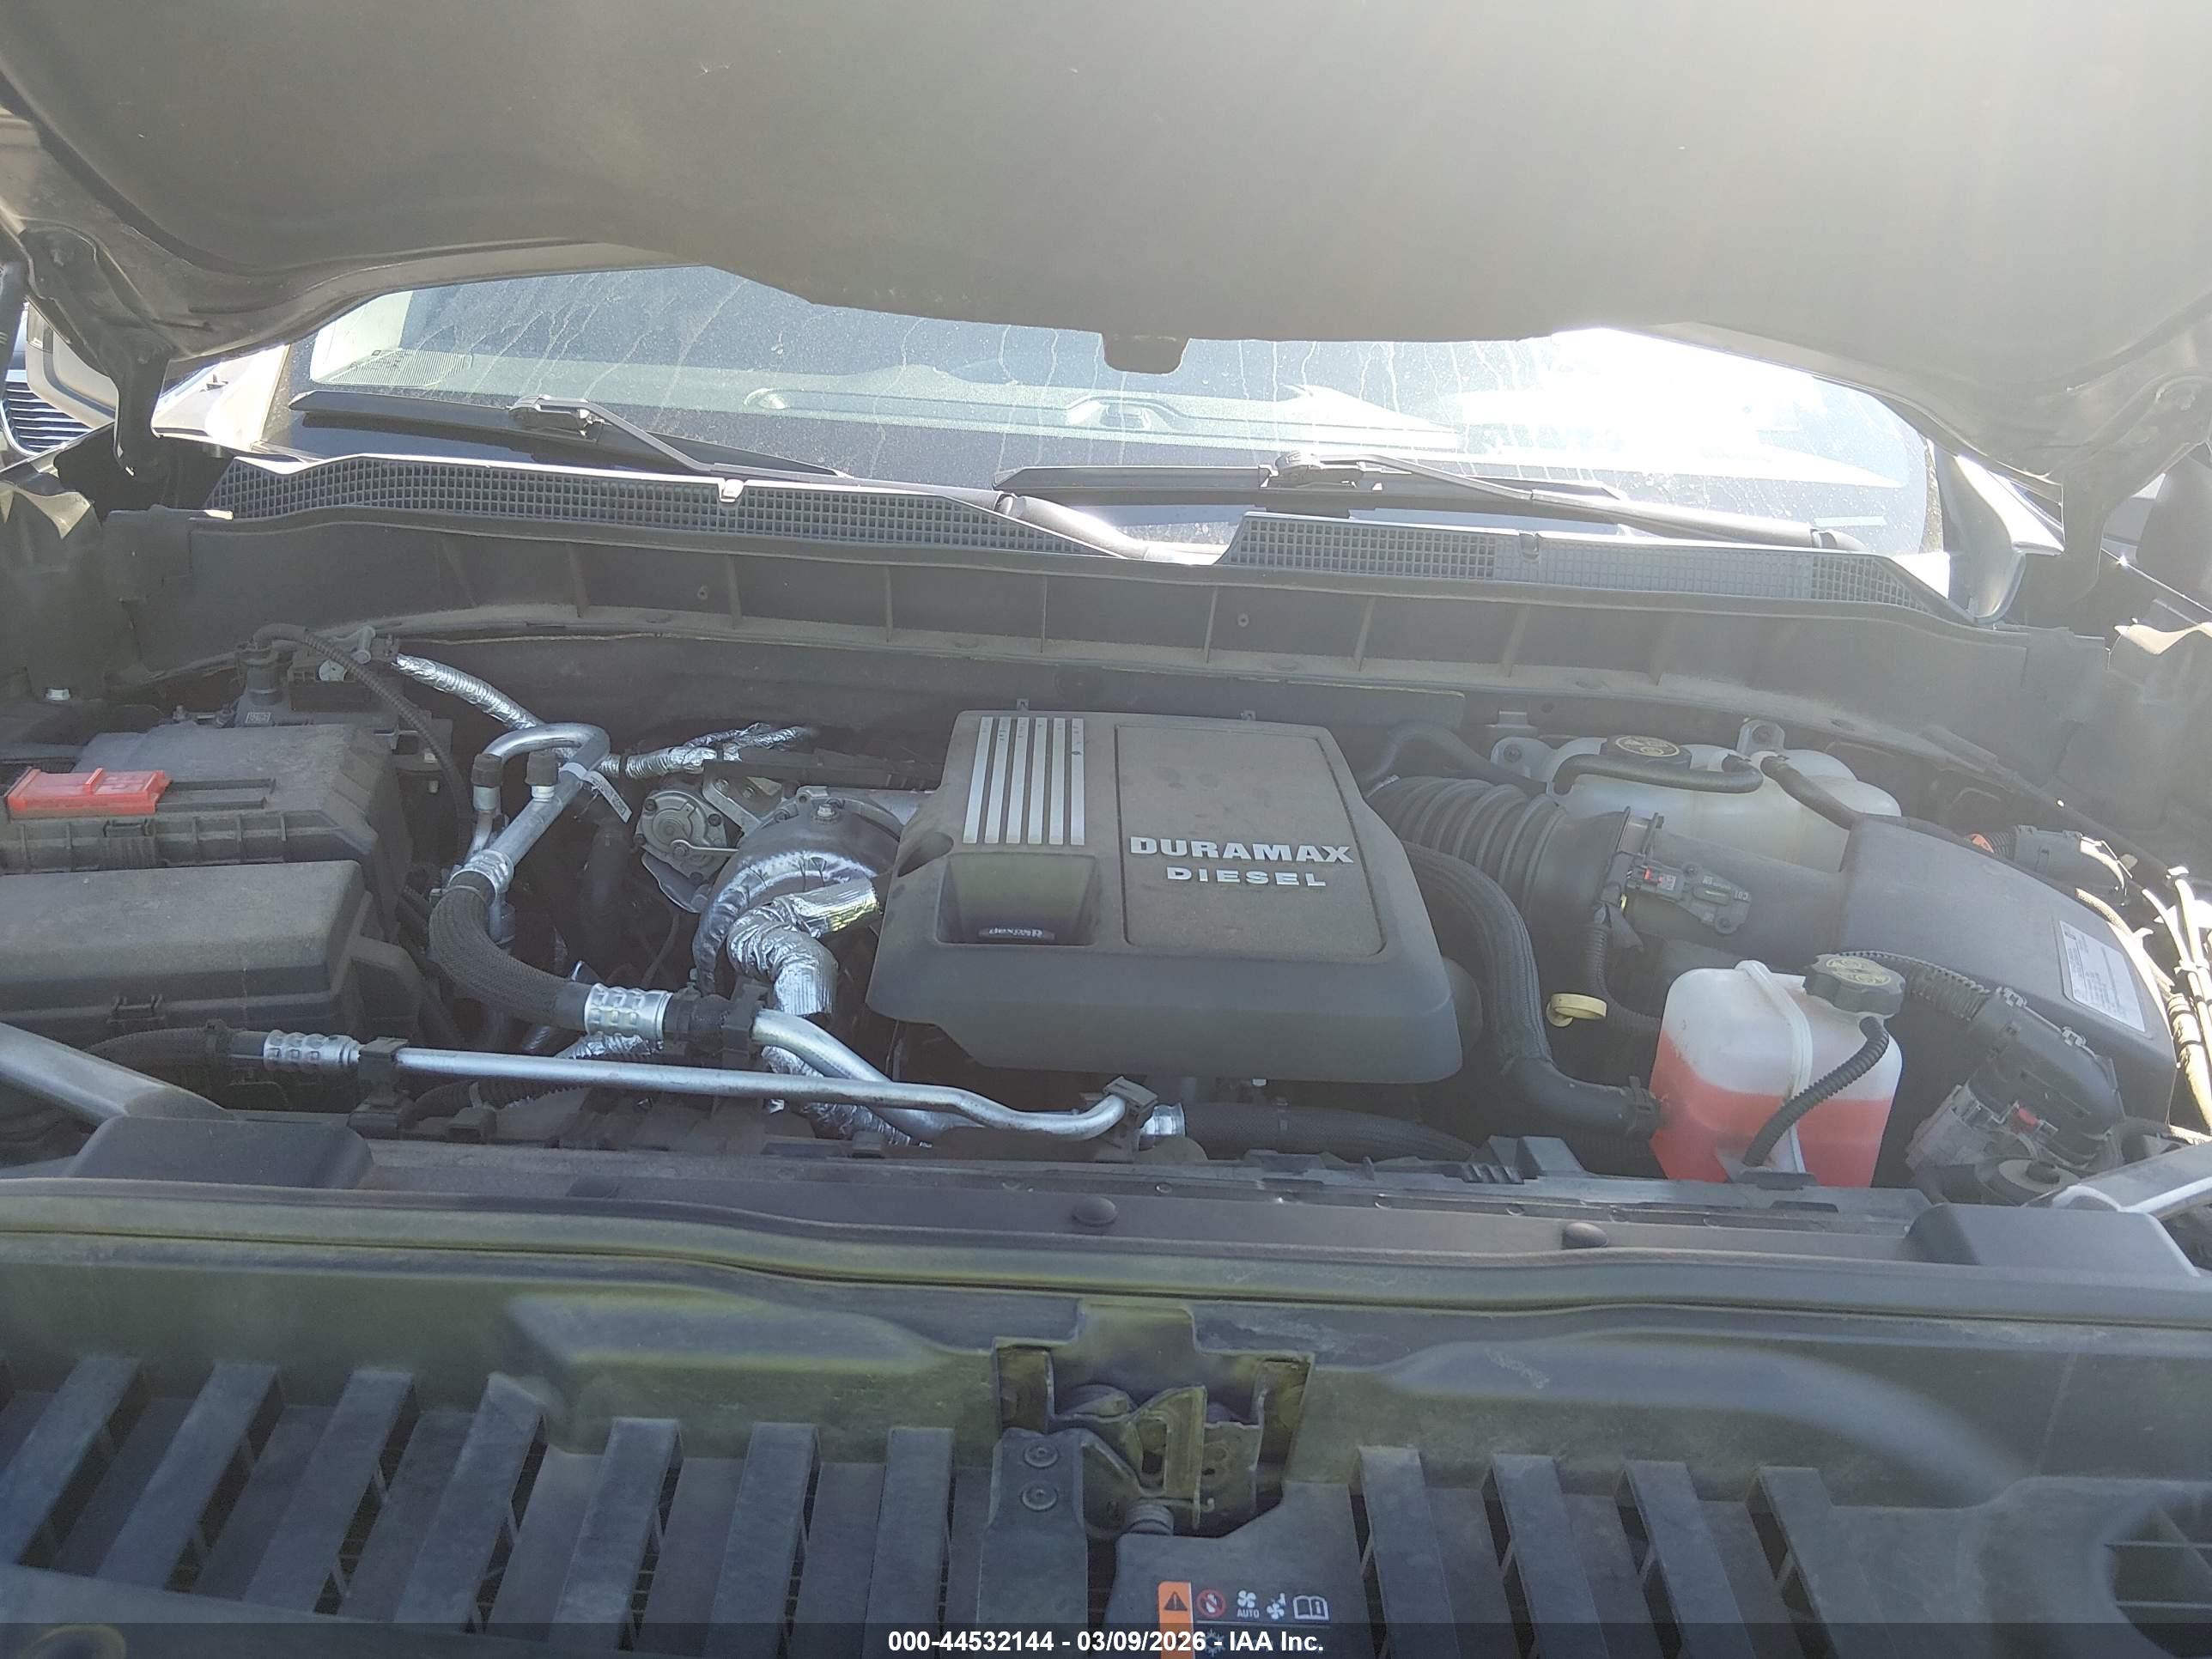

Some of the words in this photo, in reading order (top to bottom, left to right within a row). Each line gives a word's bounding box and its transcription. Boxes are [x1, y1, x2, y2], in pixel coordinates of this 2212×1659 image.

[1130, 836, 1354, 863] DURAMAX
[1167, 866, 1326, 887] DIESEL
[1237, 1607, 1260, 1619] AUTO
